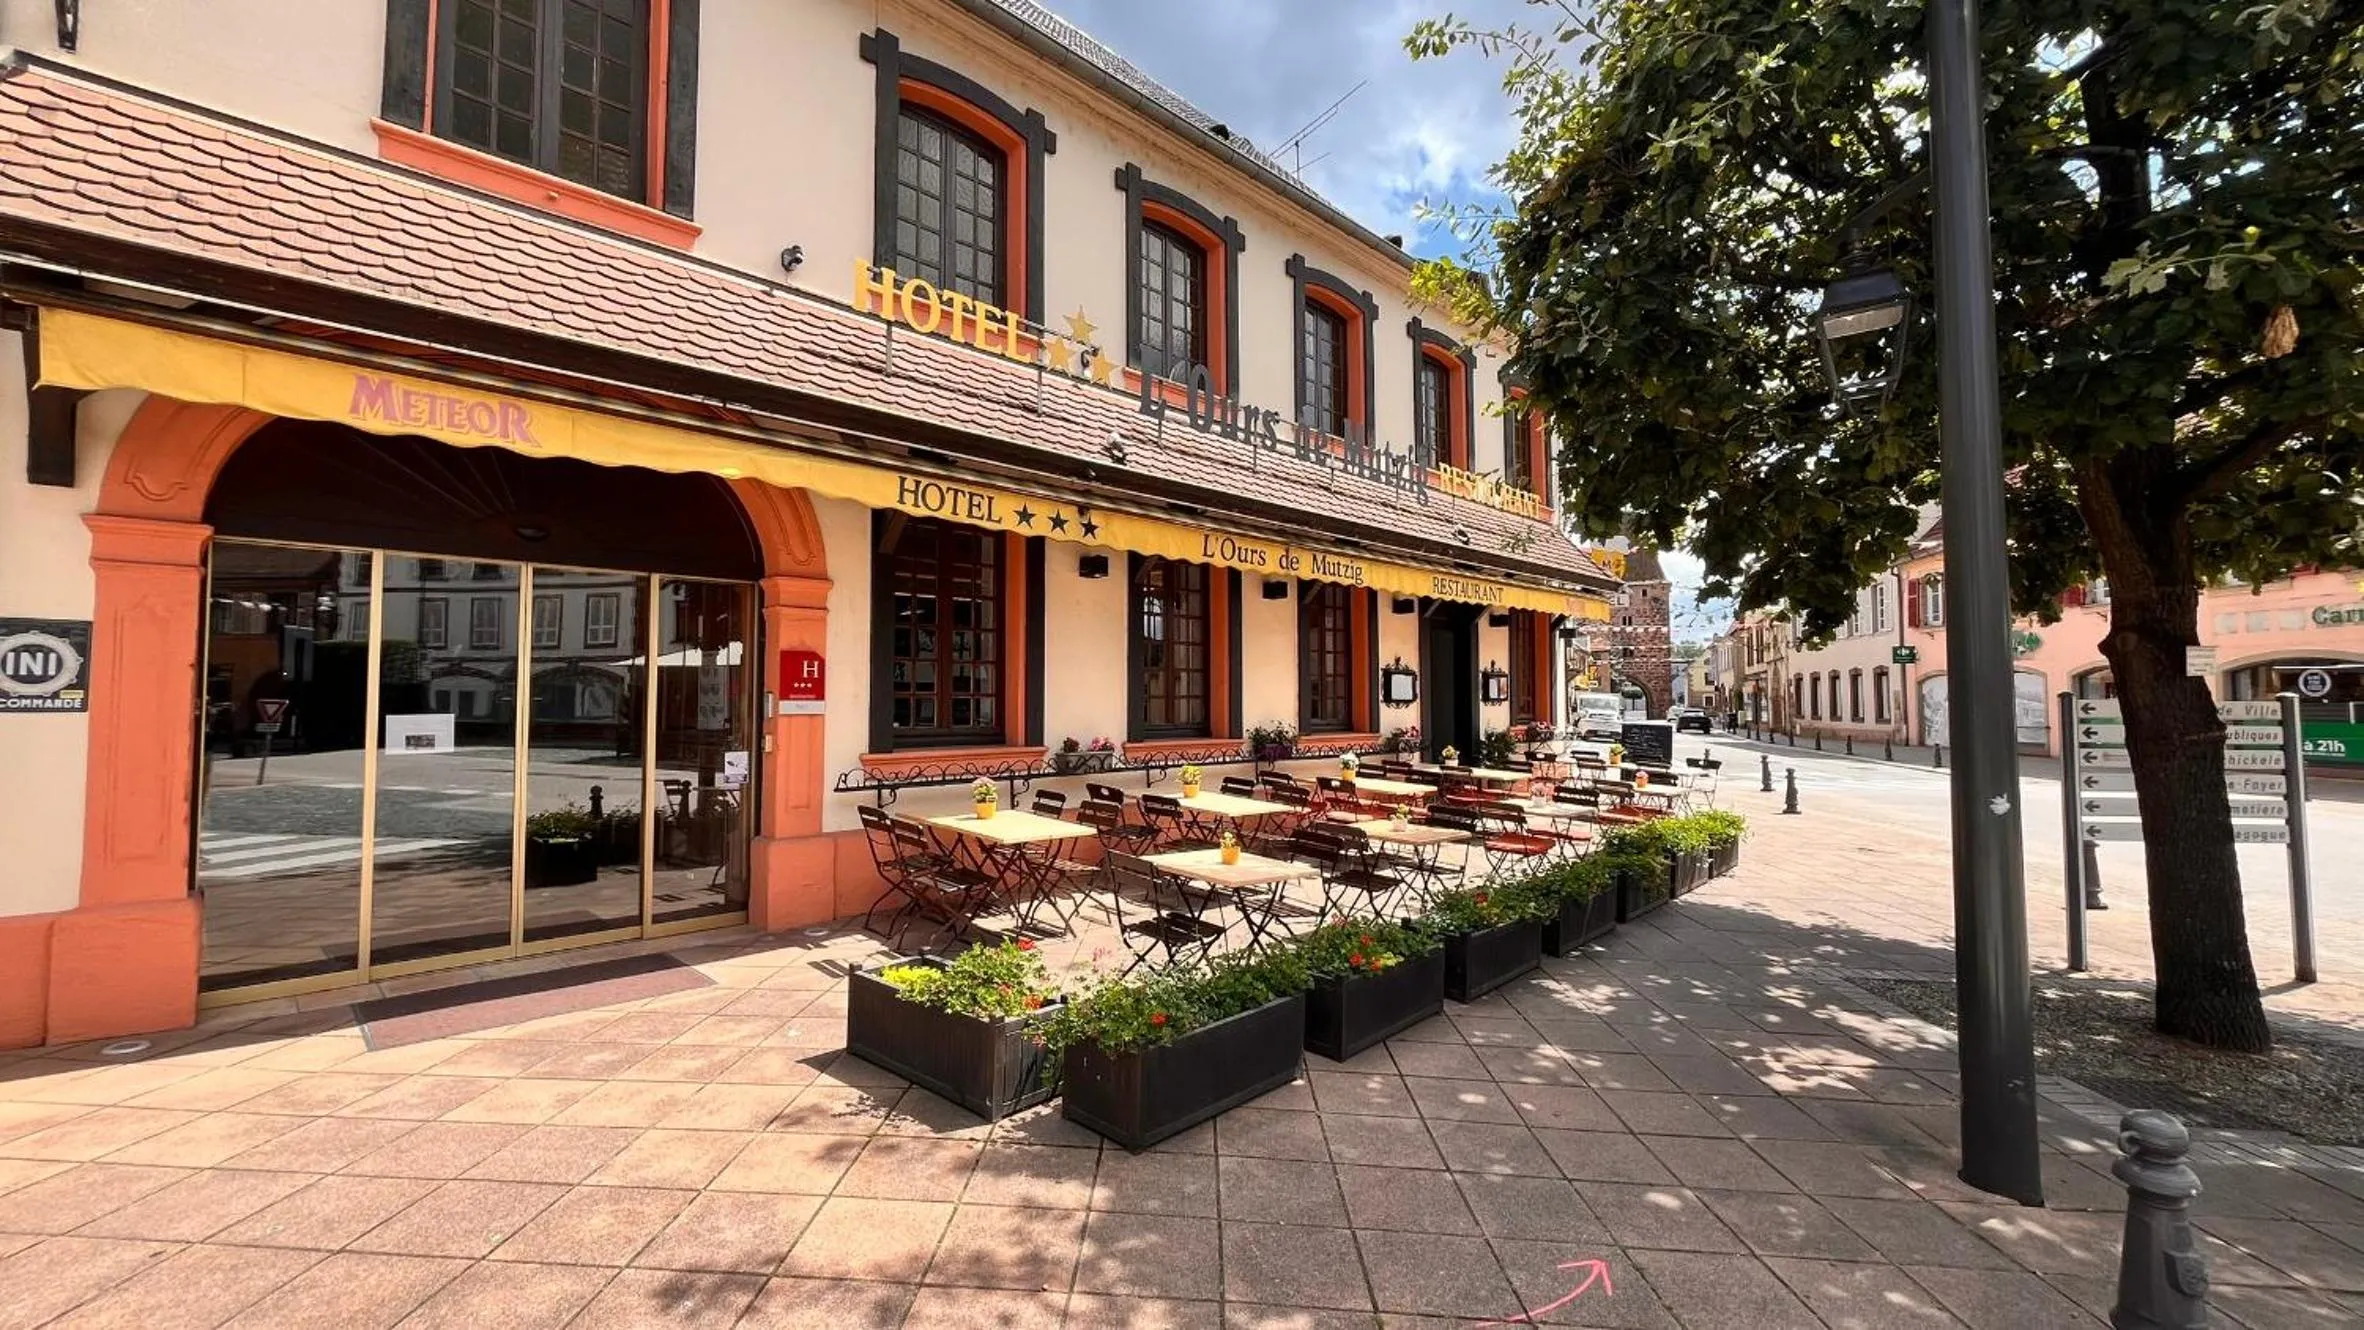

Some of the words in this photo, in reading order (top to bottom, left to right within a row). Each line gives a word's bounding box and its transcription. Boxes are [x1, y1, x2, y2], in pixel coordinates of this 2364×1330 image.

[854, 257, 1031, 363] HOTEL
[897, 475, 1003, 524] HOTEL
[1438, 461, 1543, 520] RESTAURANT
[1202, 533, 1267, 567] L'Ours
[1279, 551, 1300, 572] de
[1311, 552, 1364, 585] Mutzig
[1432, 576, 1504, 602] RESTAURANT
[802, 660, 819, 679] H
[2245, 705, 2279, 717] Ville
[2224, 728, 2279, 743] ubliques
[2317, 740, 2346, 753] 21h
[2227, 754, 2281, 766] hickele
